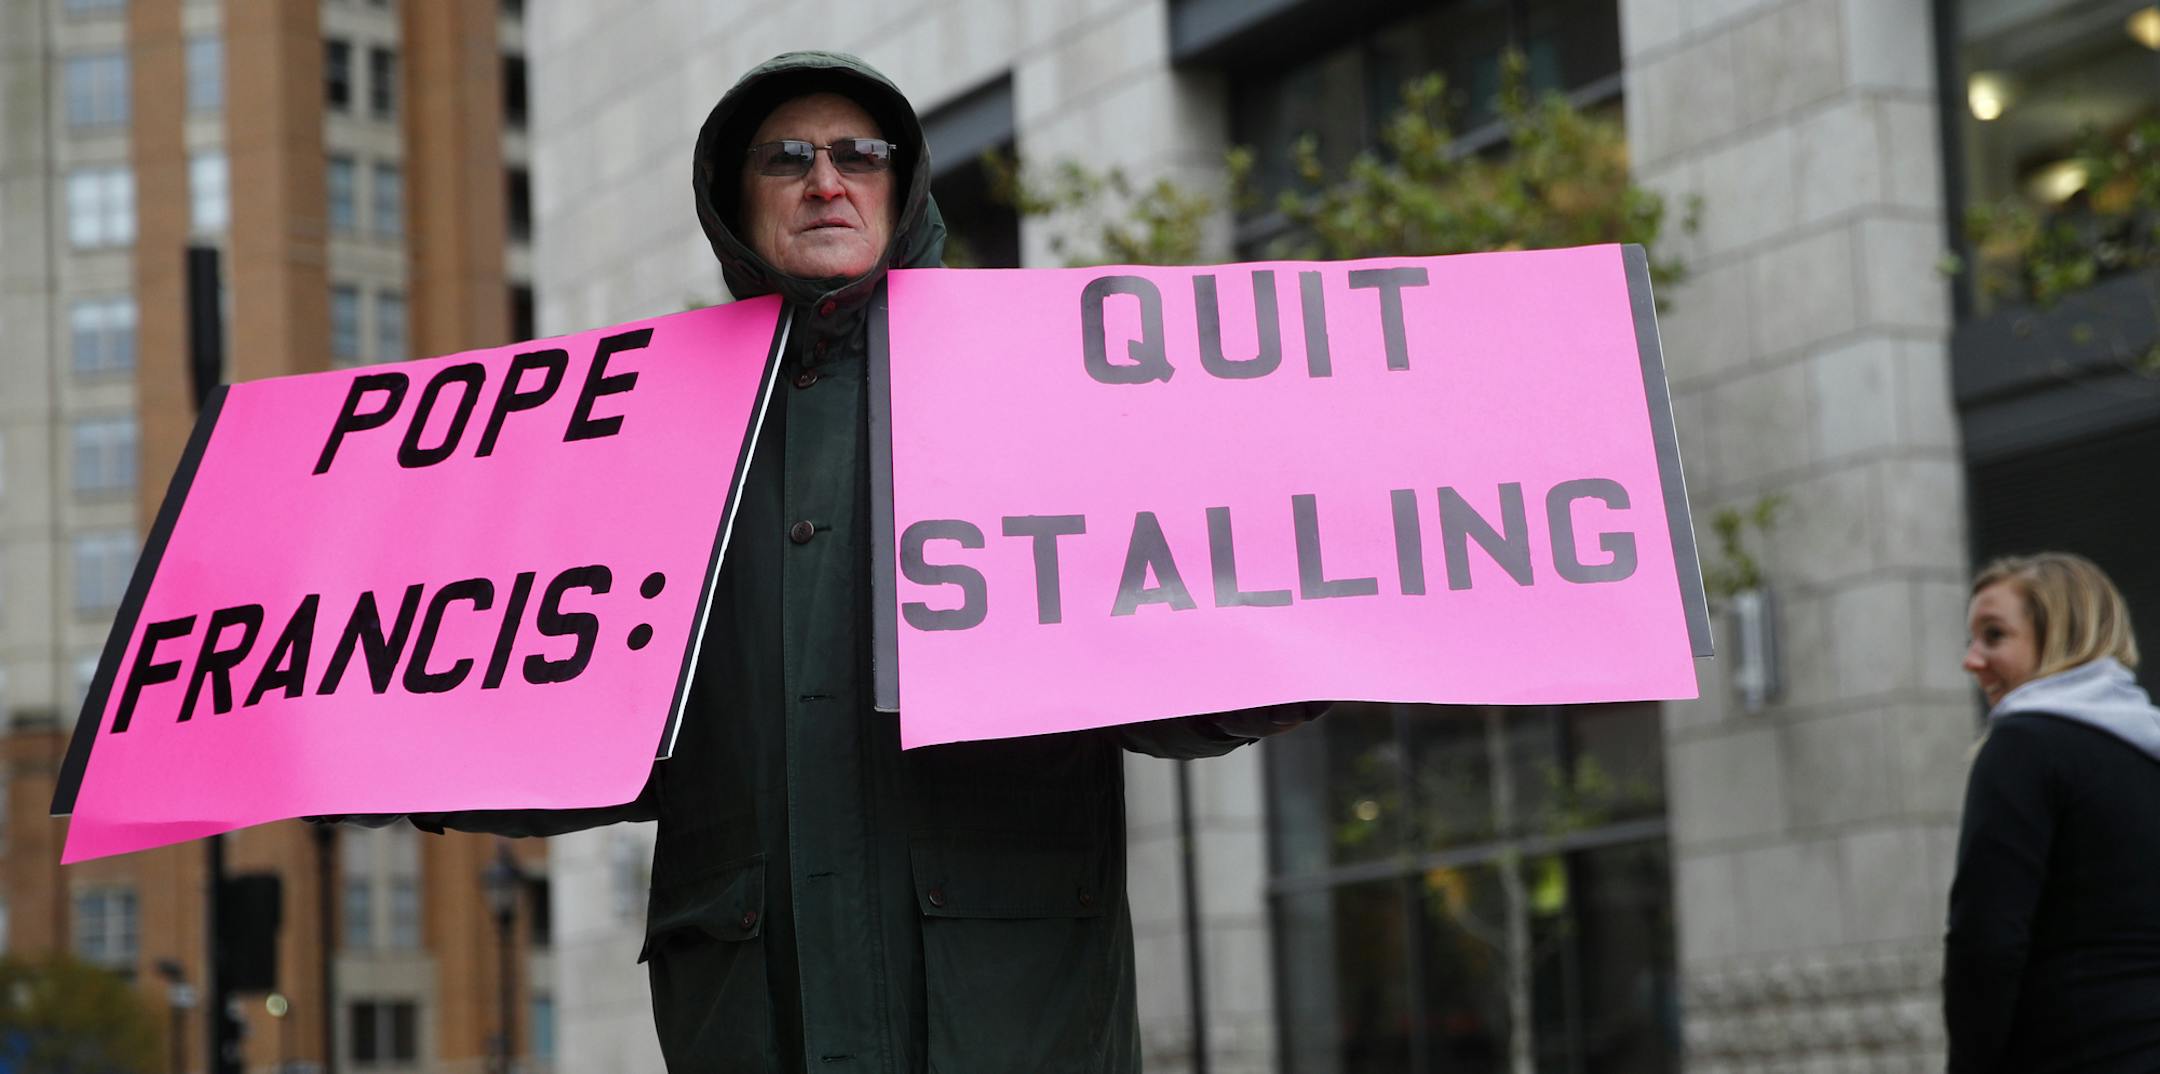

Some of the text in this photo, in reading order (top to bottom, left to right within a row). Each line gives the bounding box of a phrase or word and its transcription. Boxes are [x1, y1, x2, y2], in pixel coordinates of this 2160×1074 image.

[1081, 268, 1427, 384] QUIT
[313, 328, 654, 475] POPE
[900, 479, 1637, 631] STALLING
[111, 565, 666, 734] FRANCIS:
